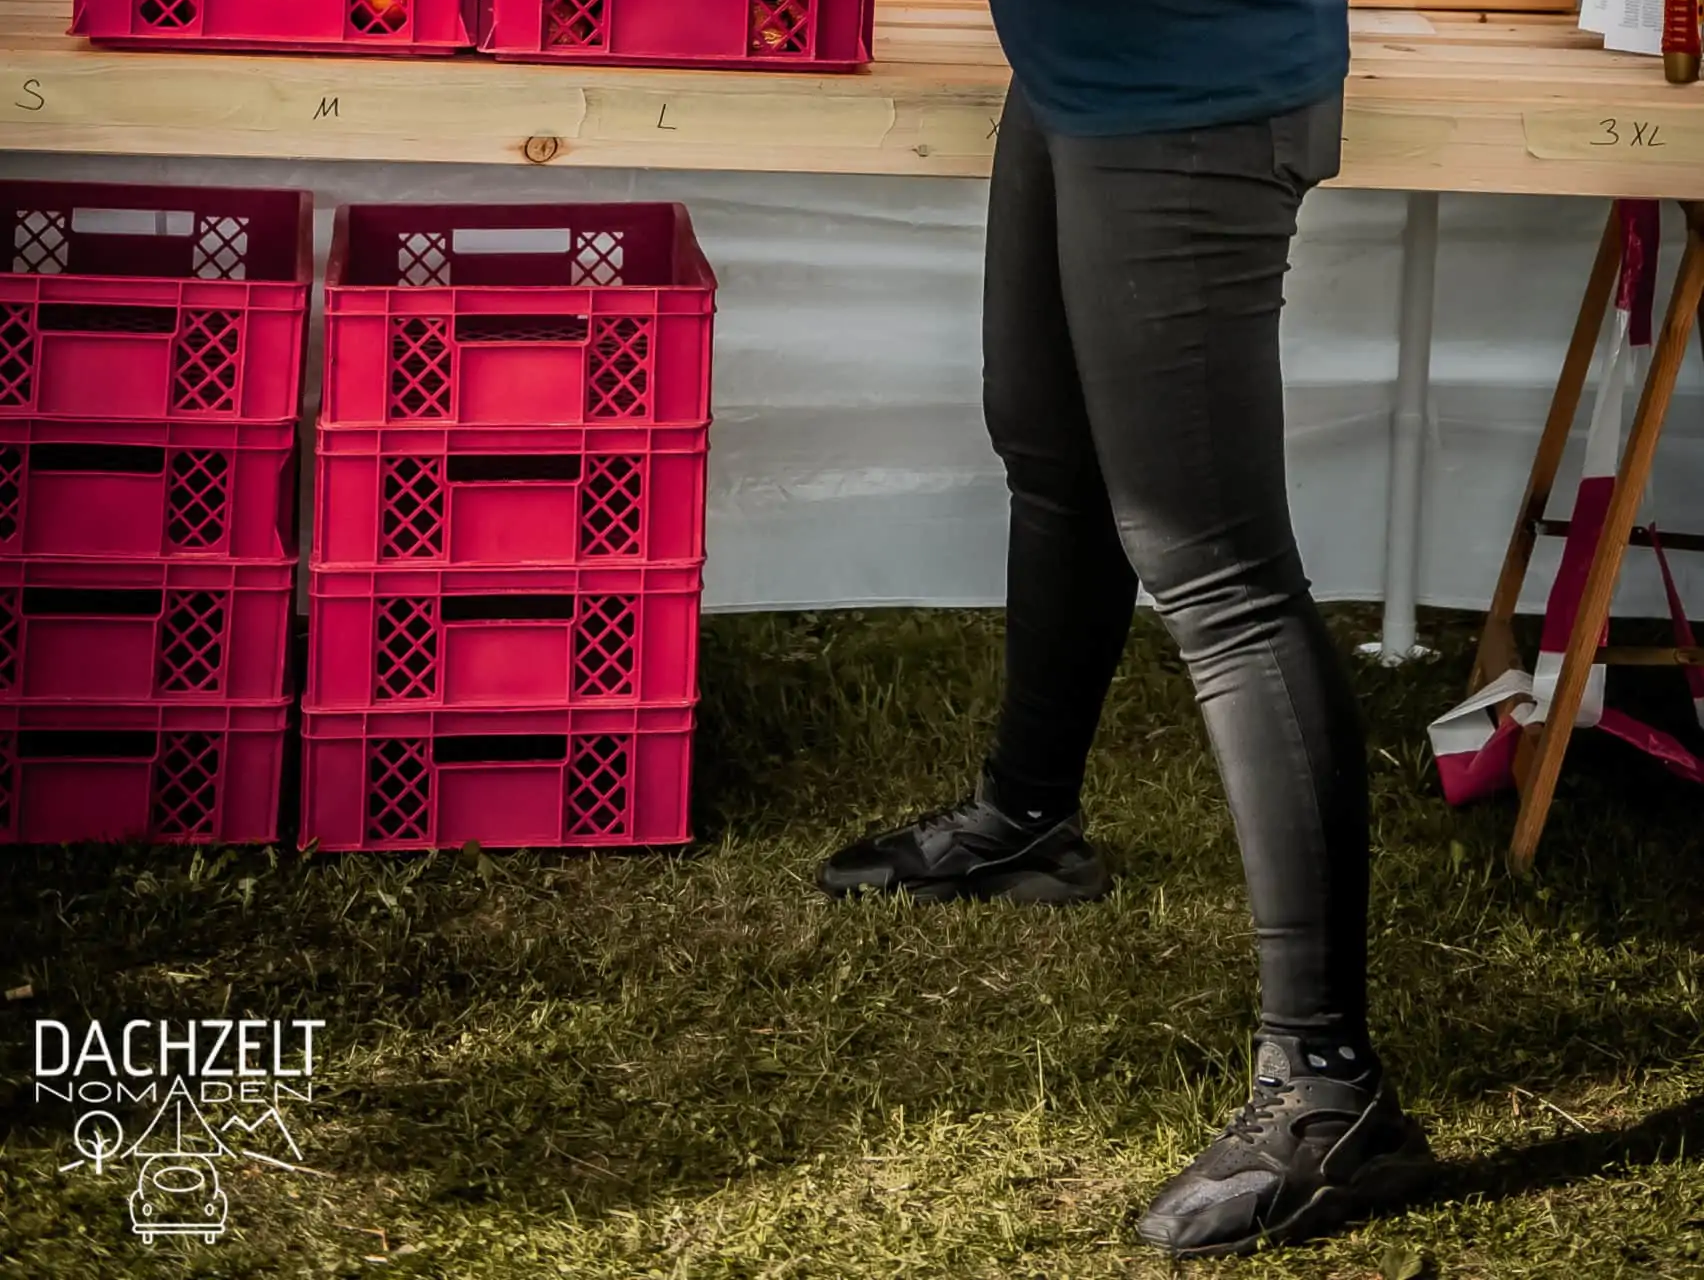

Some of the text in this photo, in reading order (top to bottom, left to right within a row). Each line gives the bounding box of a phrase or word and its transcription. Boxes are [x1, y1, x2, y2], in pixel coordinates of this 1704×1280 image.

[15, 79, 45, 111] S
[313, 97, 338, 120] M
[657, 103, 677, 130] L
